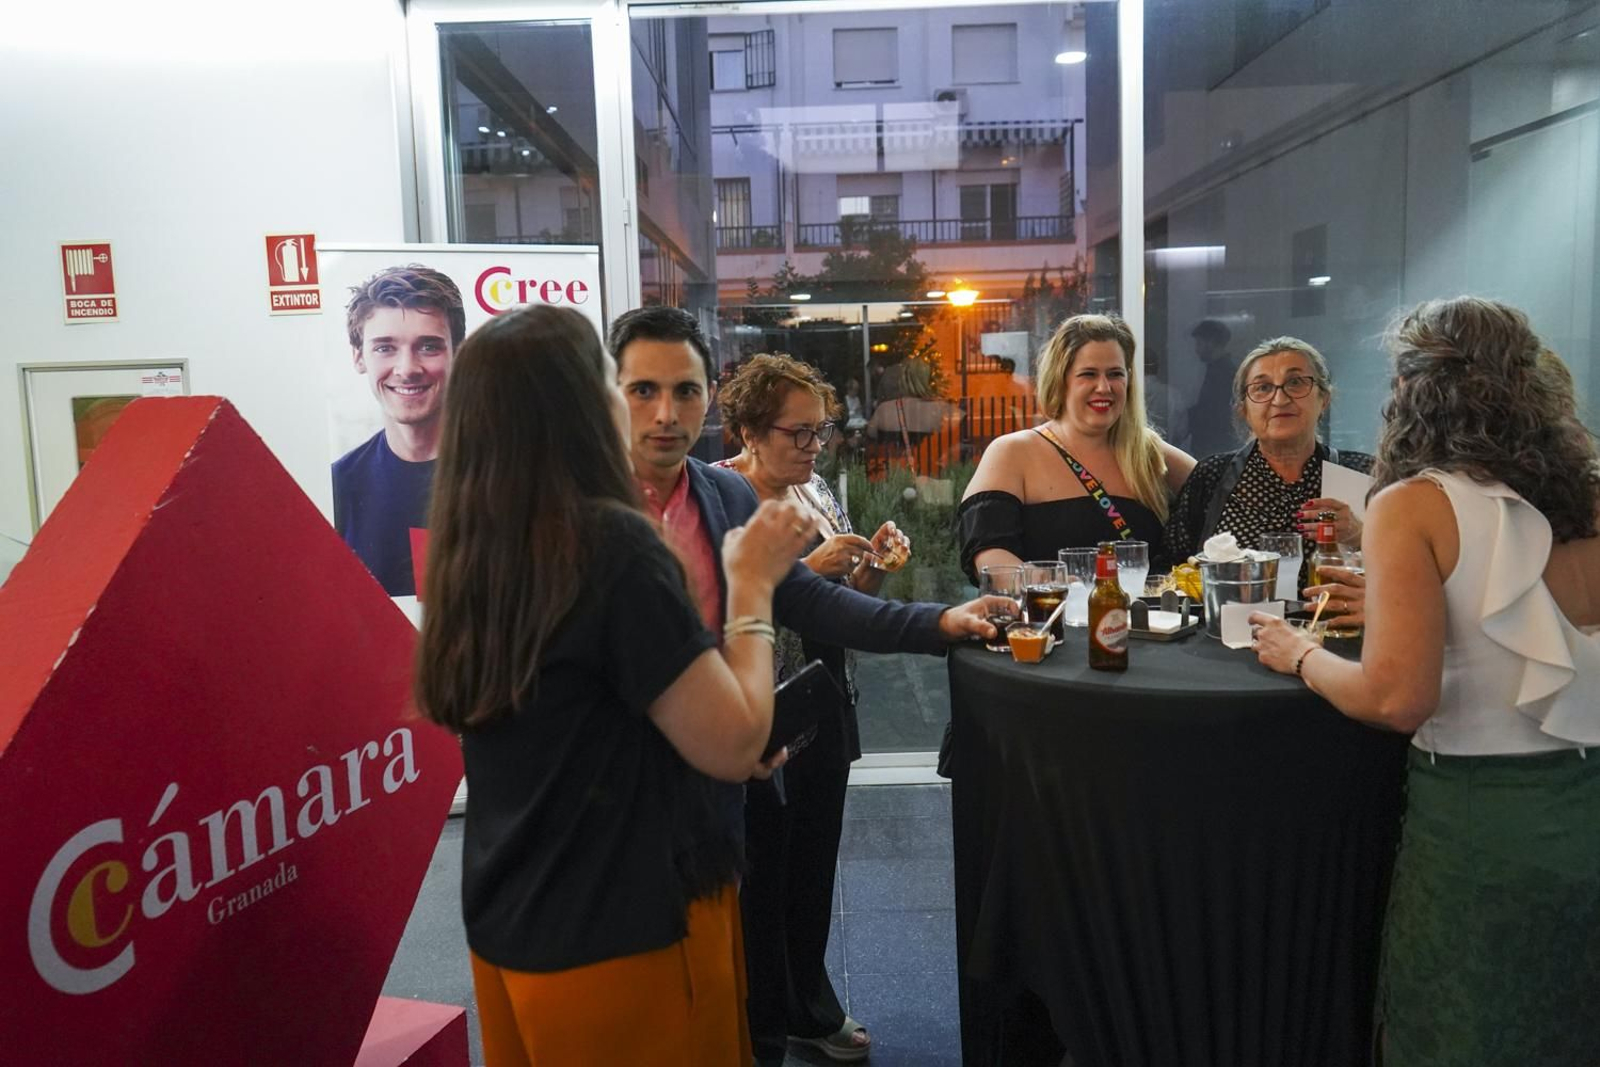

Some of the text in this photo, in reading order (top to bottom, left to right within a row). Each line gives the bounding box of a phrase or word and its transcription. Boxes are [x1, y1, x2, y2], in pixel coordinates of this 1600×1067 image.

[70, 299, 114, 308] BOCA DE
[272, 292, 319, 307] EXTINTOR
[71, 307, 114, 316] INCENDIO
[207, 861, 299, 926] Granada
